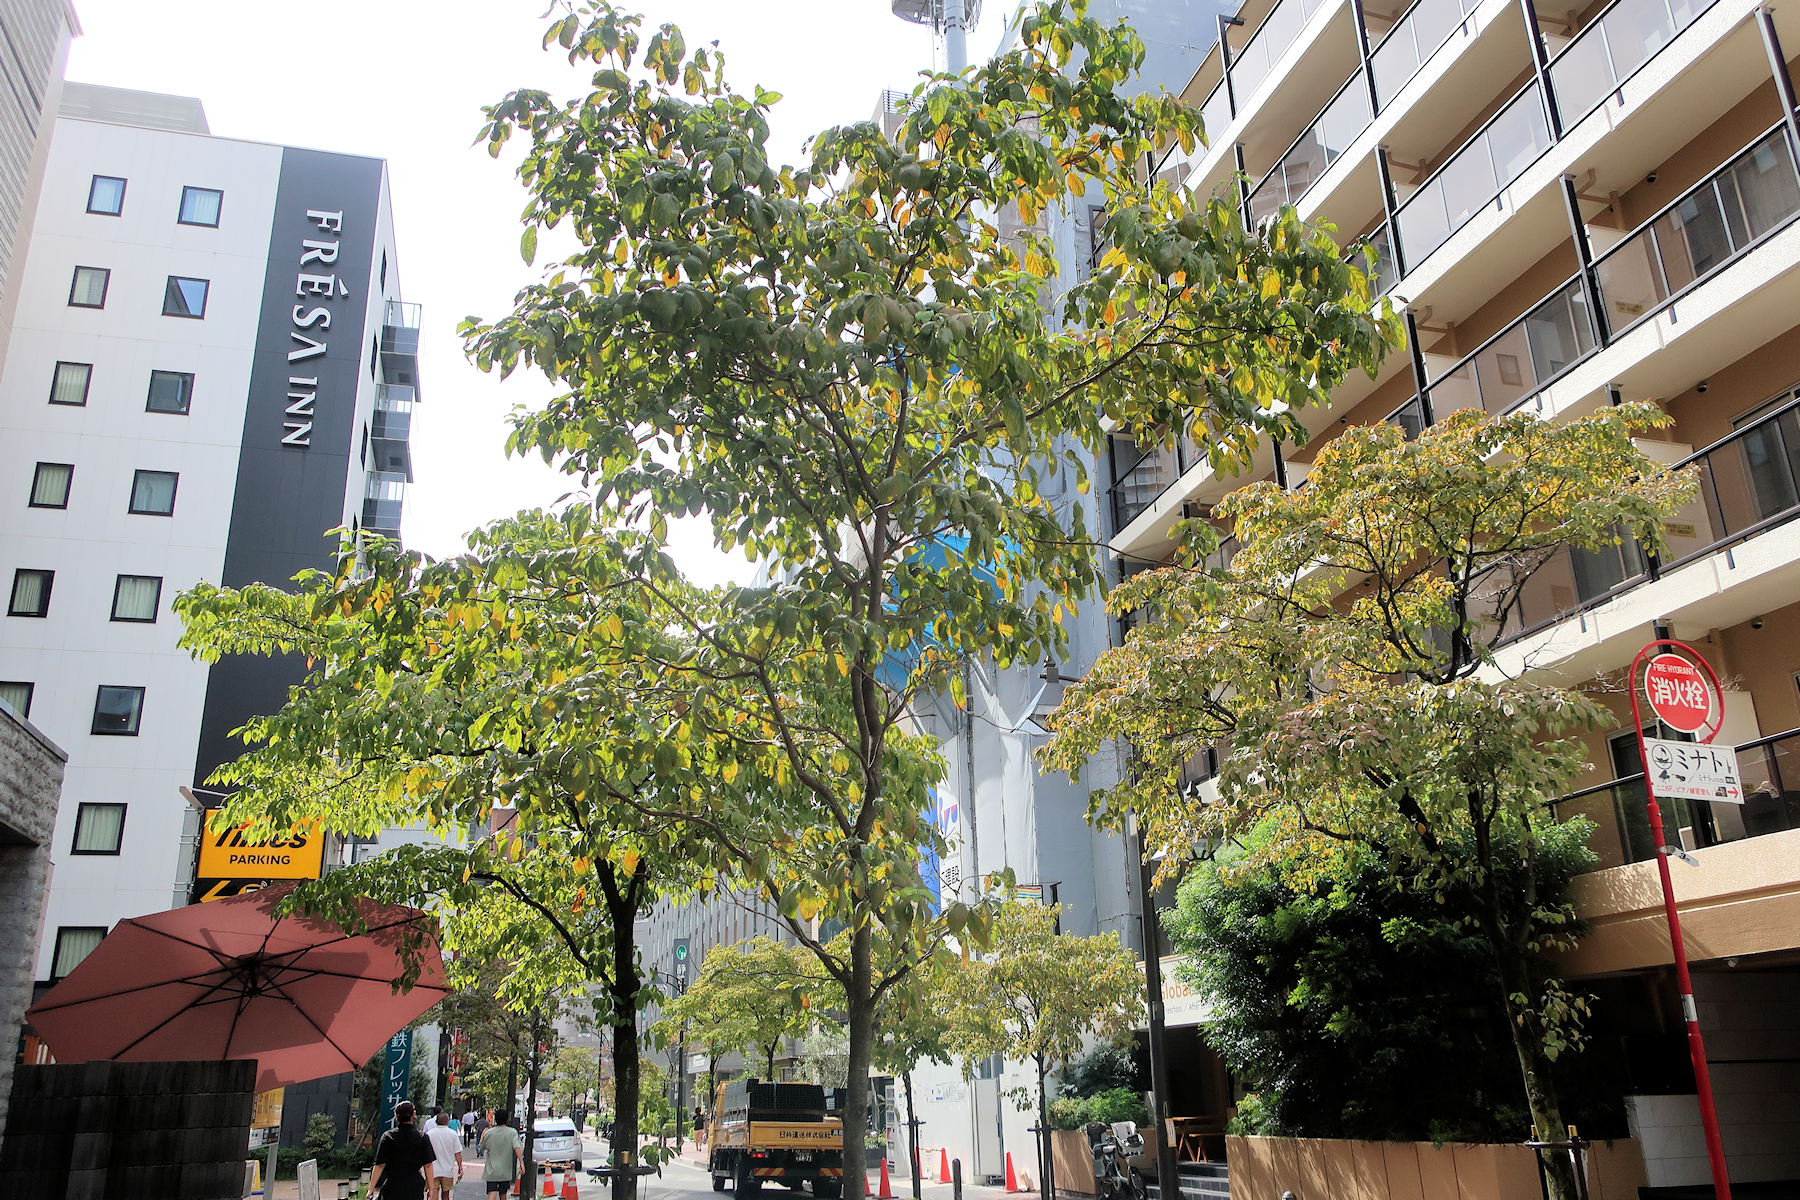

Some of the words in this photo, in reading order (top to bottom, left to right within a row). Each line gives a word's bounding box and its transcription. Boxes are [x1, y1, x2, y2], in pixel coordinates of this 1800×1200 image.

[287, 209, 349, 362] FRÉSA
[281, 376, 318, 446] INN
[1653, 663, 1667, 673] FIRE
[1667, 665, 1695, 676] HYDRANT
[1650, 676, 1707, 710] 消火栓
[1676, 748, 1723, 773] ミナト
[229, 854, 291, 865] PARKING
[1164, 1004, 1182, 1014] reschool
